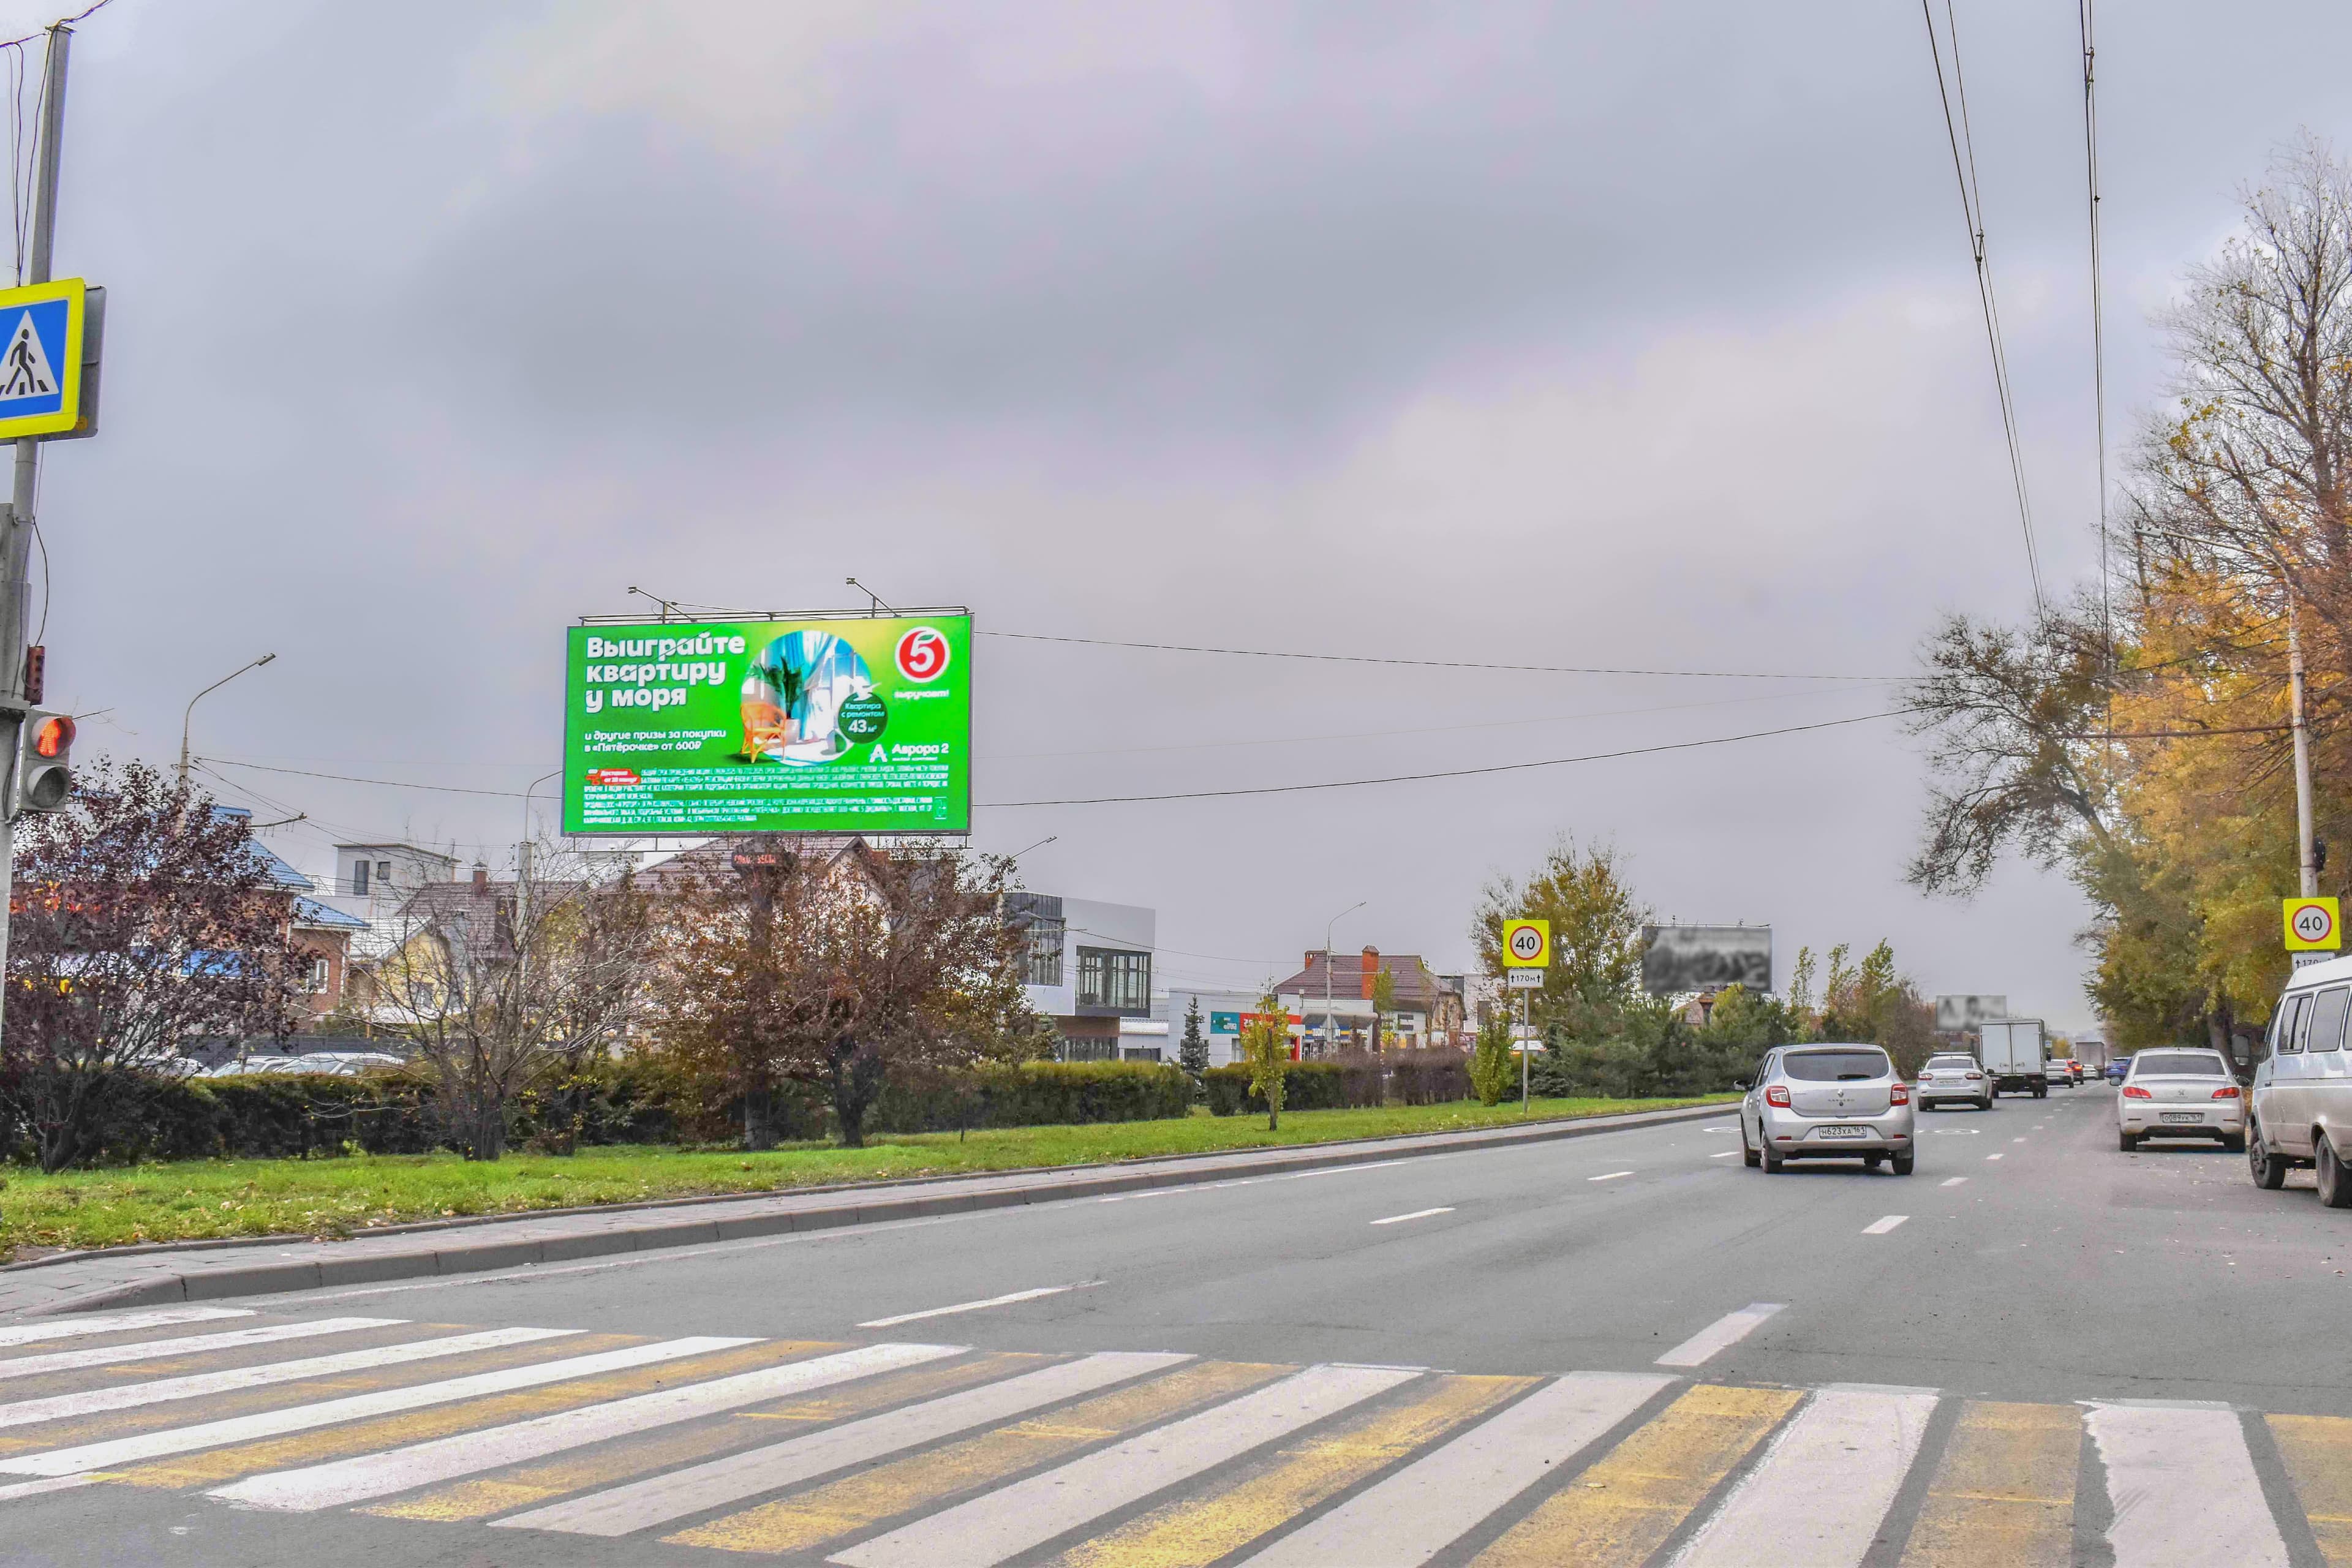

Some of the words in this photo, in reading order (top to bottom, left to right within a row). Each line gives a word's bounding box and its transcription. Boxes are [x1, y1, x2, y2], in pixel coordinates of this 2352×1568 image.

[587, 632, 745, 661] Выиграйте
[909, 631, 936, 672] 5
[586, 662, 726, 687] квартиру
[586, 690, 603, 713] у
[612, 688, 687, 711] моря
[848, 719, 867, 733] 43
[594, 731, 631, 742] другие
[633, 731, 666, 741] призы
[682, 730, 726, 740] покупки
[892, 744, 939, 756] Аврора
[941, 743, 949, 753] 2
[2299, 916, 2323, 931] 40
[1515, 937, 1535, 950] 40
